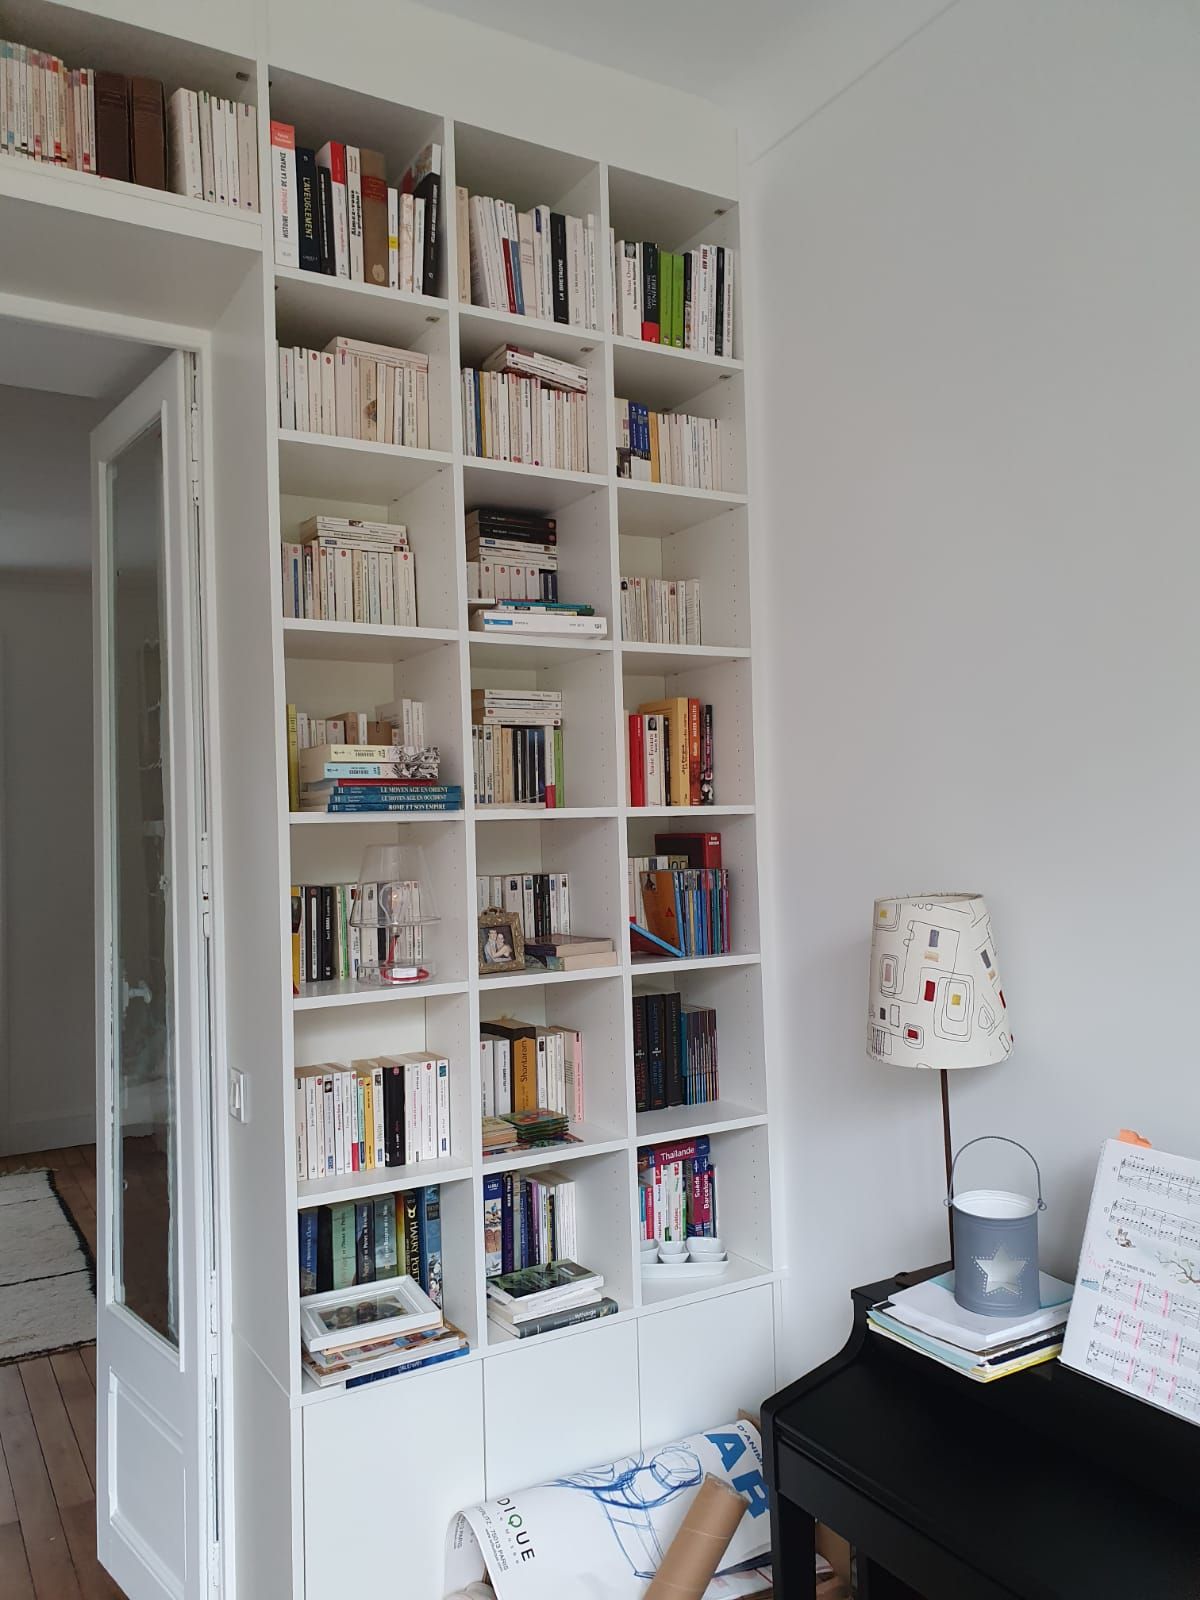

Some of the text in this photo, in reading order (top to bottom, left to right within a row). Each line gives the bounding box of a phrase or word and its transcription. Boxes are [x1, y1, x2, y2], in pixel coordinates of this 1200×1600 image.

[279, 151, 287, 172] FRANCE
[302, 176, 313, 240] L'AVEUGLEMENT
[281, 215, 289, 239] HISTOIRE
[558, 292, 565, 301] LA
[519, 1039, 528, 1082] Shantaram
[660, 1147, 695, 1161] Thaïlande
[702, 1174, 710, 1209] Barcelone
[409, 1221, 420, 1285] HARRY POTT
[496, 1497, 536, 1562] DIQUE
